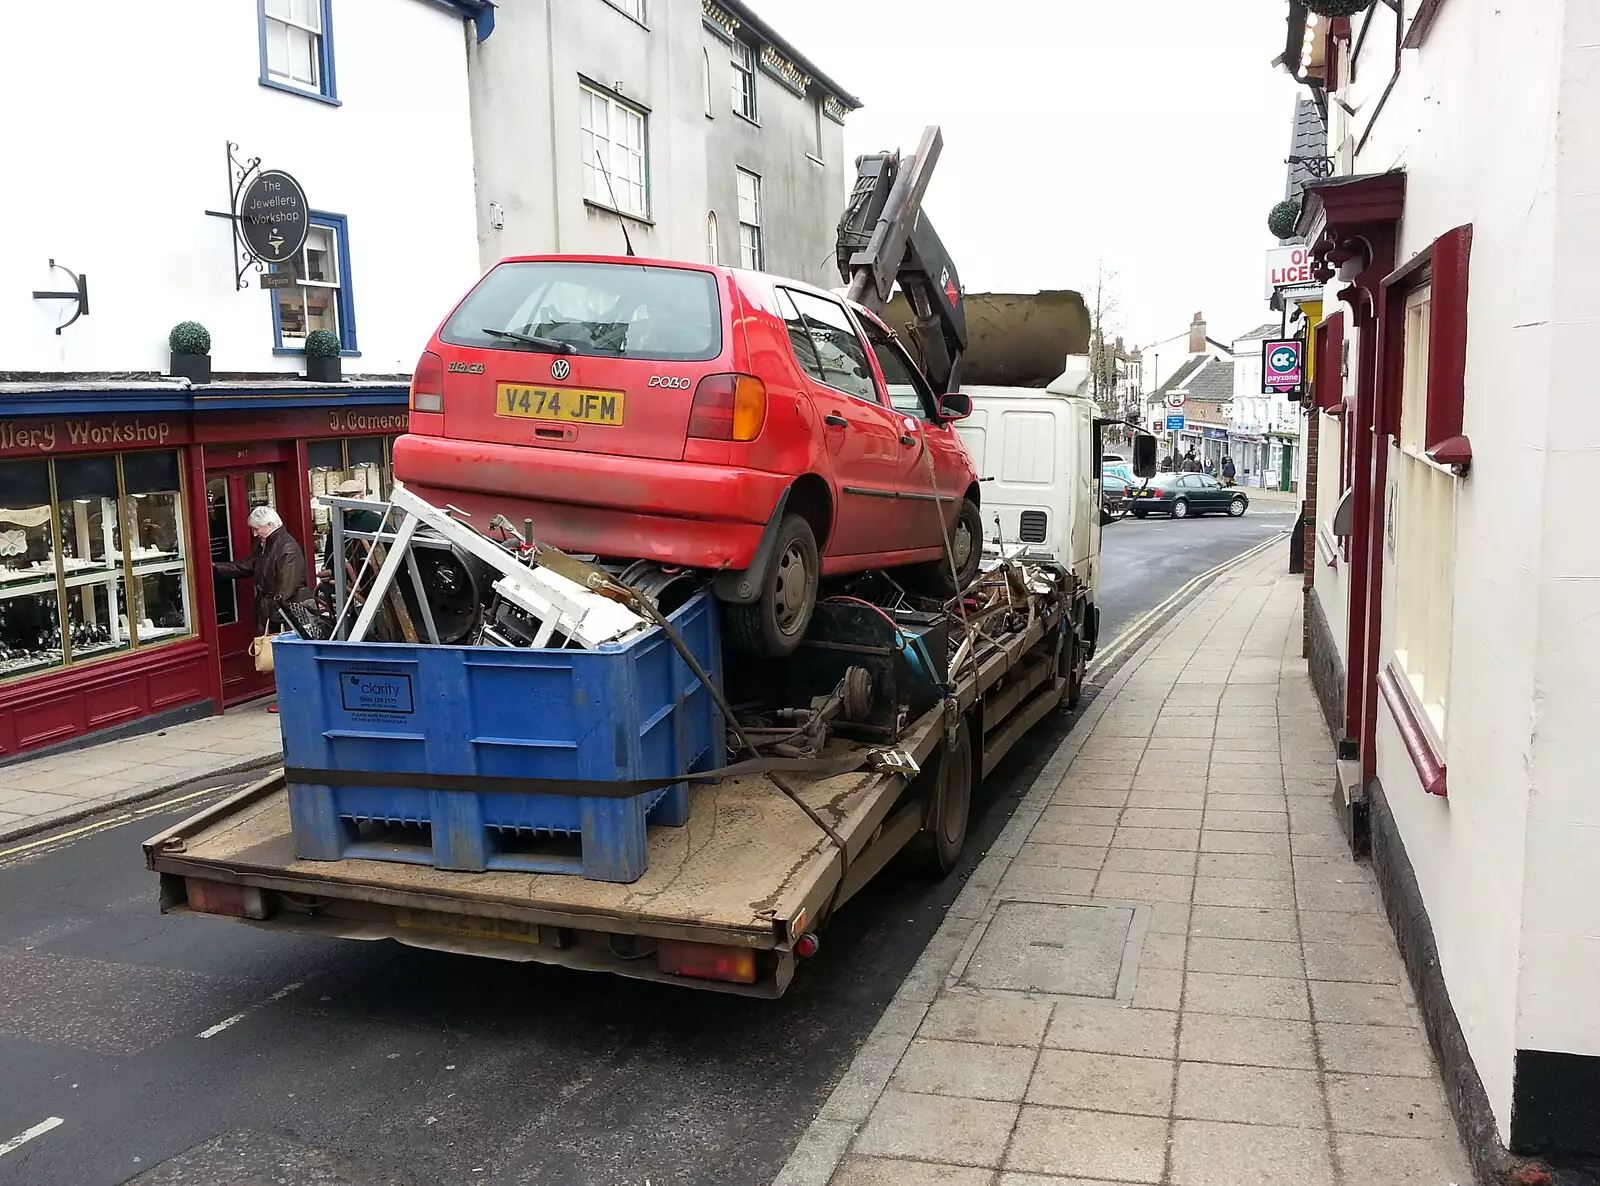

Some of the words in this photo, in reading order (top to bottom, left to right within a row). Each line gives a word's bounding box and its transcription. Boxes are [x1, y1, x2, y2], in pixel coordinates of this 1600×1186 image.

[263, 181, 281, 191] The
[250, 196, 296, 209] Jewellery
[250, 211, 299, 225] Workshop
[648, 375, 691, 390] POLO
[1267, 374, 1299, 383] payzone
[505, 388, 561, 416] V474
[570, 393, 617, 421] JFM
[65, 418, 170, 445] Workshop
[361, 682, 400, 698] clarity
